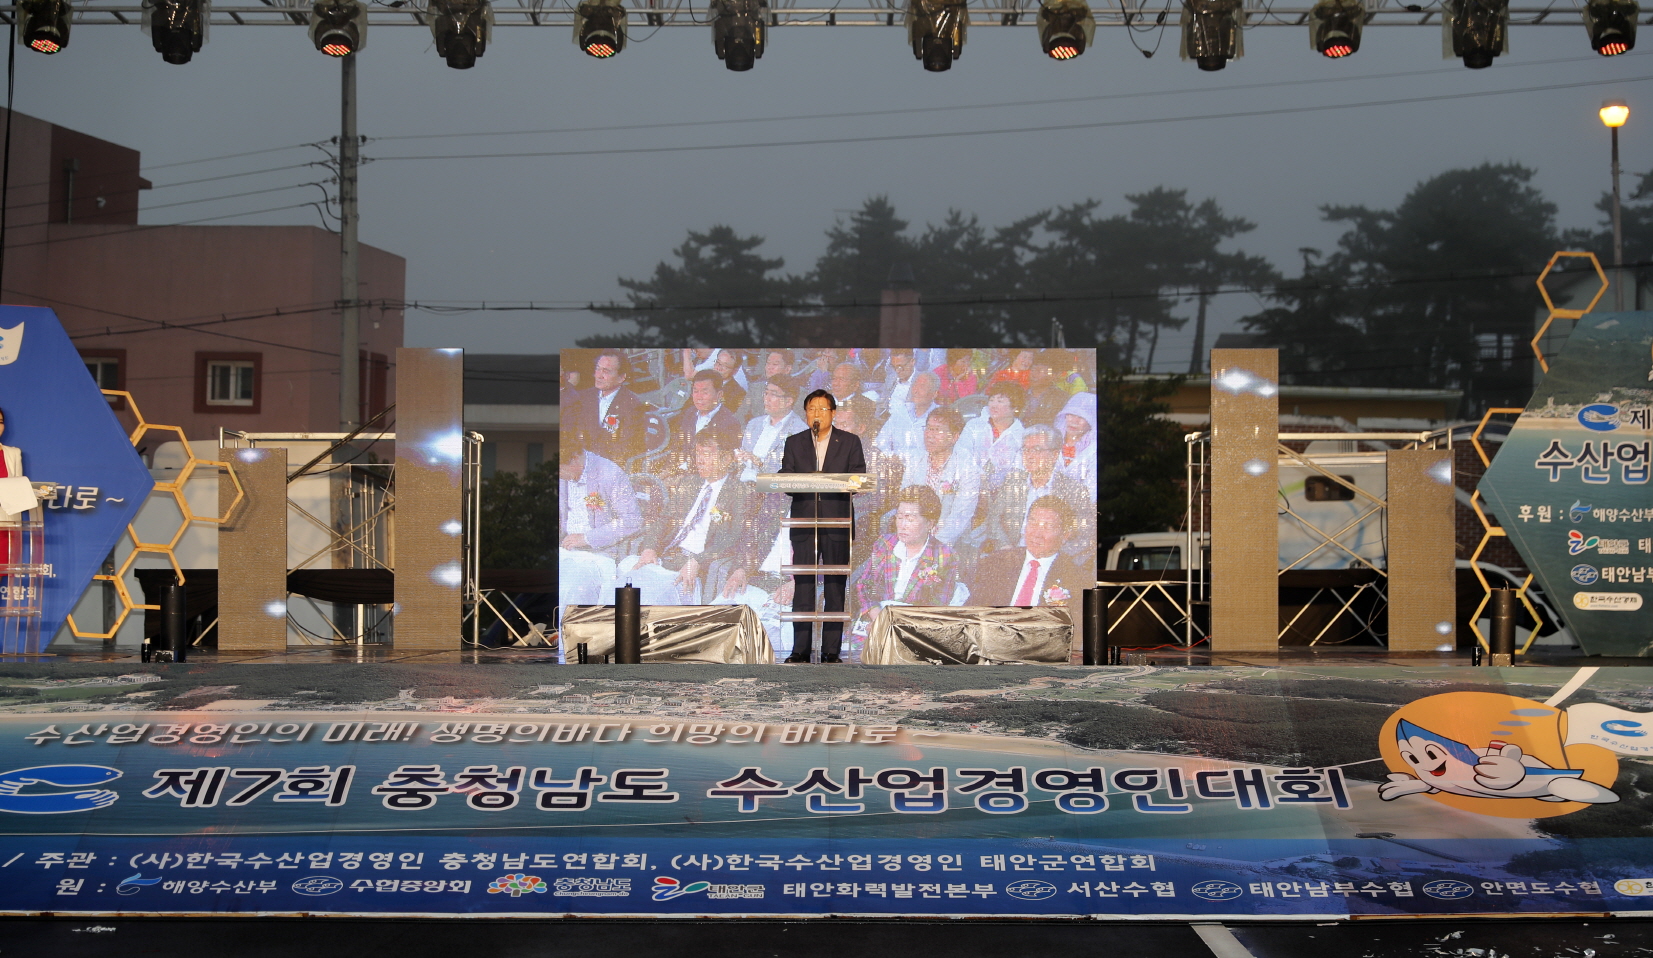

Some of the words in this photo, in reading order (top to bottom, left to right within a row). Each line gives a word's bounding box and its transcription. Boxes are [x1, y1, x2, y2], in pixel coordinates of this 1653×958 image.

[24, 722, 313, 745] 수산업경영인의
[321, 722, 420, 742] 미래!
[643, 722, 766, 744] 희망의
[142, 764, 356, 808] 제7회
[371, 764, 680, 812] 충청남도
[706, 765, 1354, 815] 수산업경영인대회
[35, 852, 97, 869] 주관
[129, 851, 425, 870] (사)한국수산업경영인
[670, 853, 963, 873] (사)한국수산업경영인
[979, 854, 1157, 872] 태안군연합회
[162, 880, 277, 894] 해양수산부
[553, 877, 632, 891] 충청남도
[783, 882, 998, 899] 태안화력발전본부
[1066, 881, 1176, 898] 서산수협
[1249, 881, 1414, 898] 태안남부수협
[1480, 881, 1602, 895] 안면도수협
